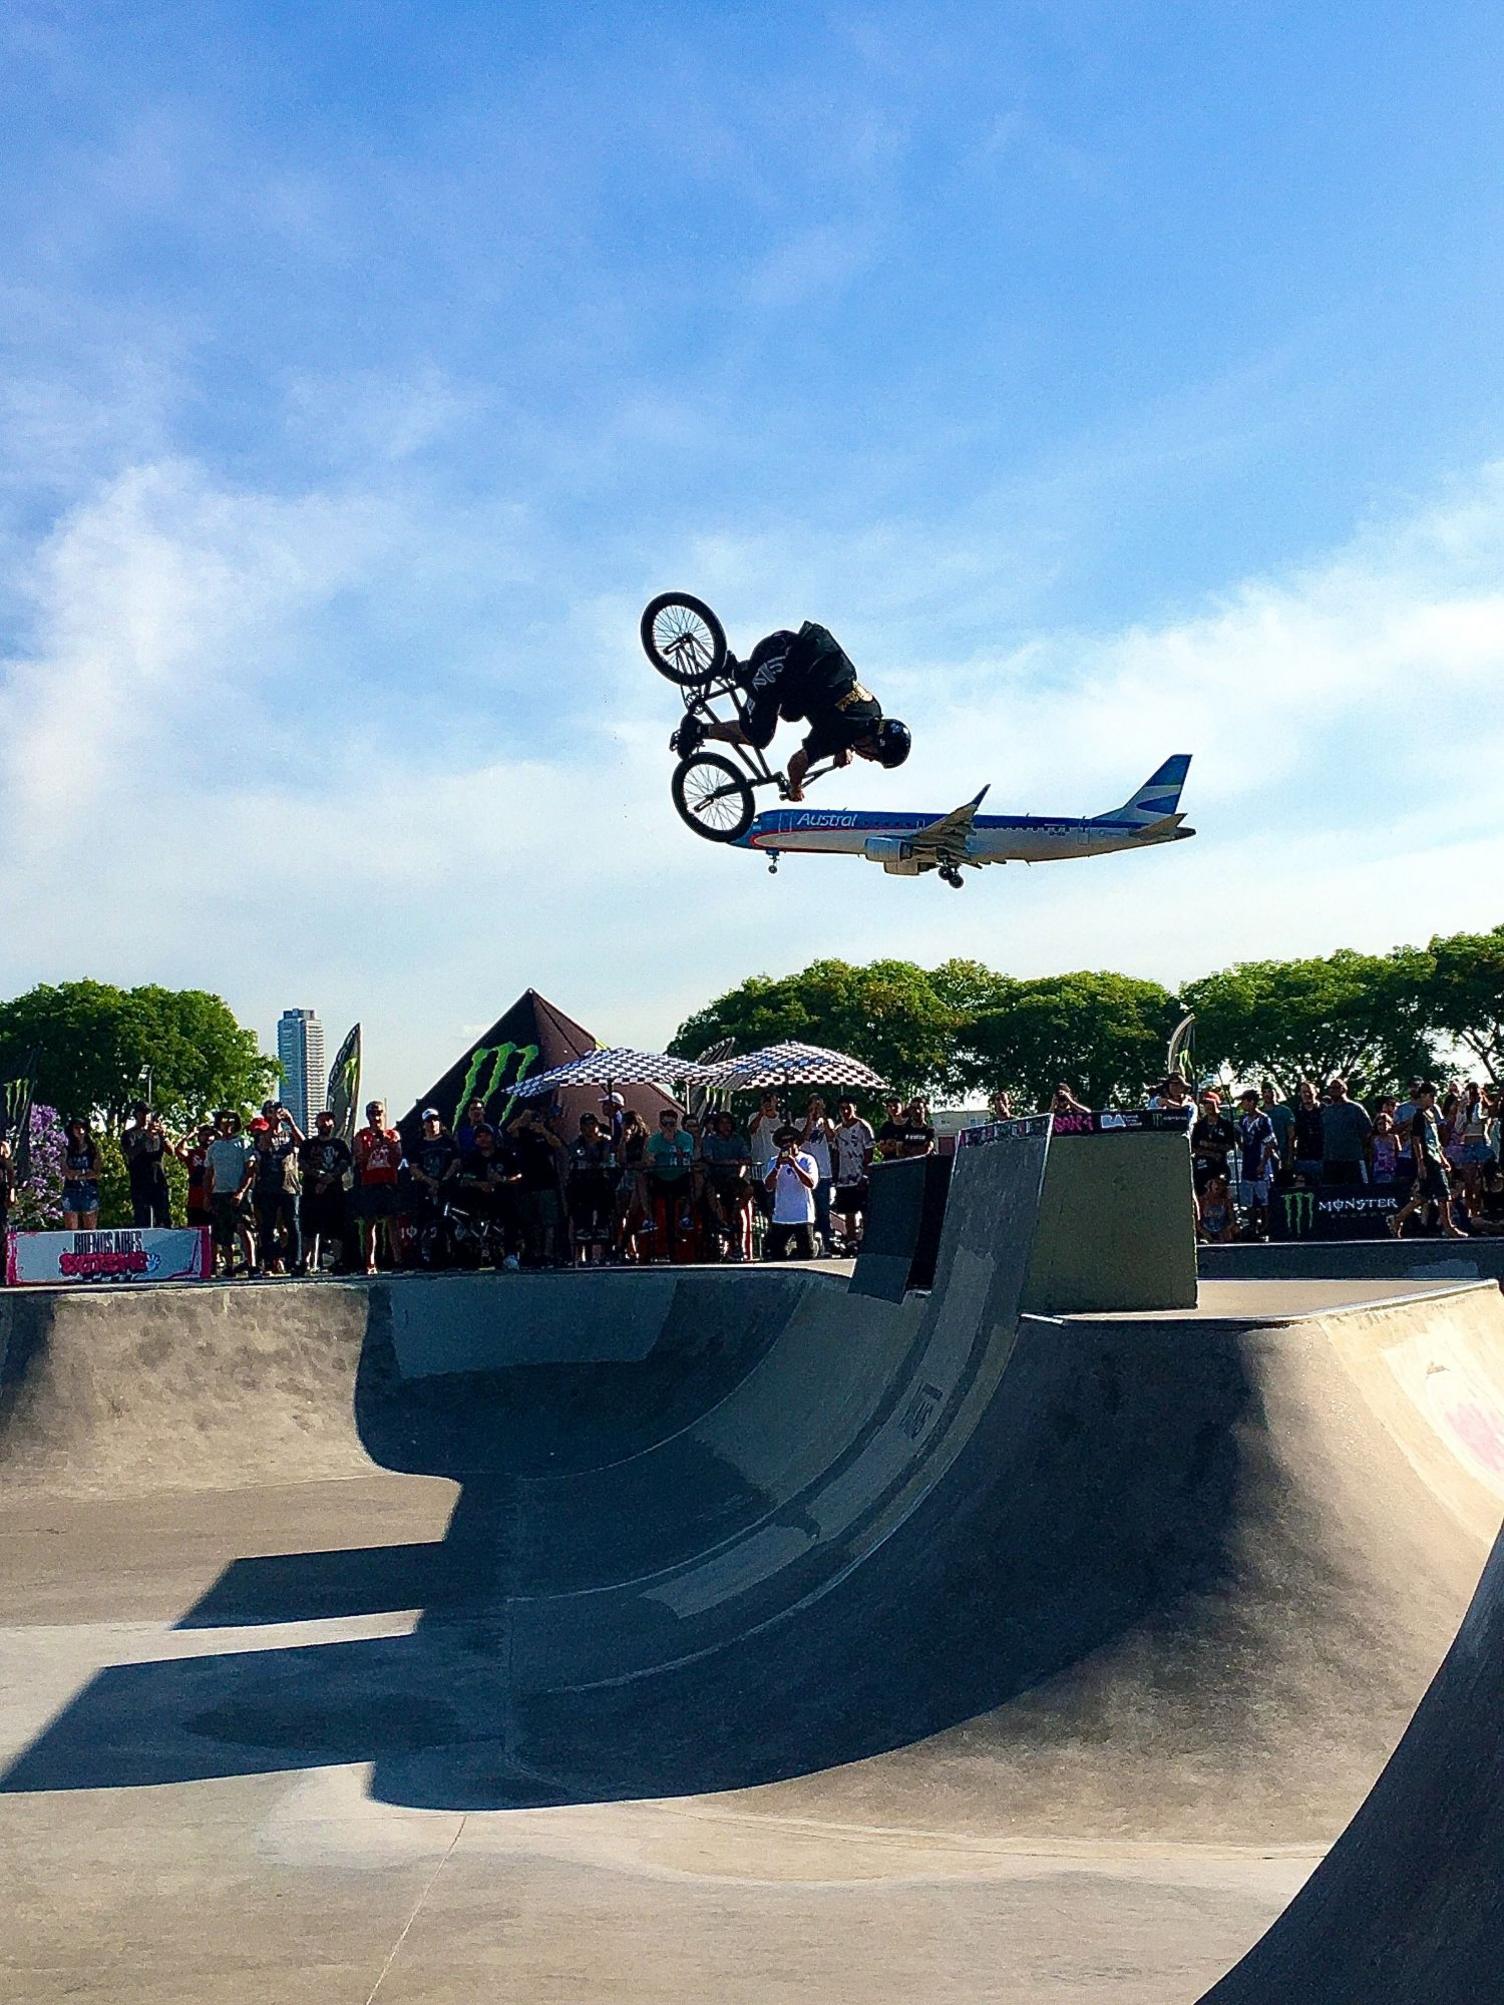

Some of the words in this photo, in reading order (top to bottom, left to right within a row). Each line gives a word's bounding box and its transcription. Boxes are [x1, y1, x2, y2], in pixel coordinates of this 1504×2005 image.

[796, 812, 859, 827] Austral
[1318, 1197, 1399, 1213] MONSTER
[73, 1232, 112, 1254] BUENOS
[114, 1231, 143, 1253] AIRES
